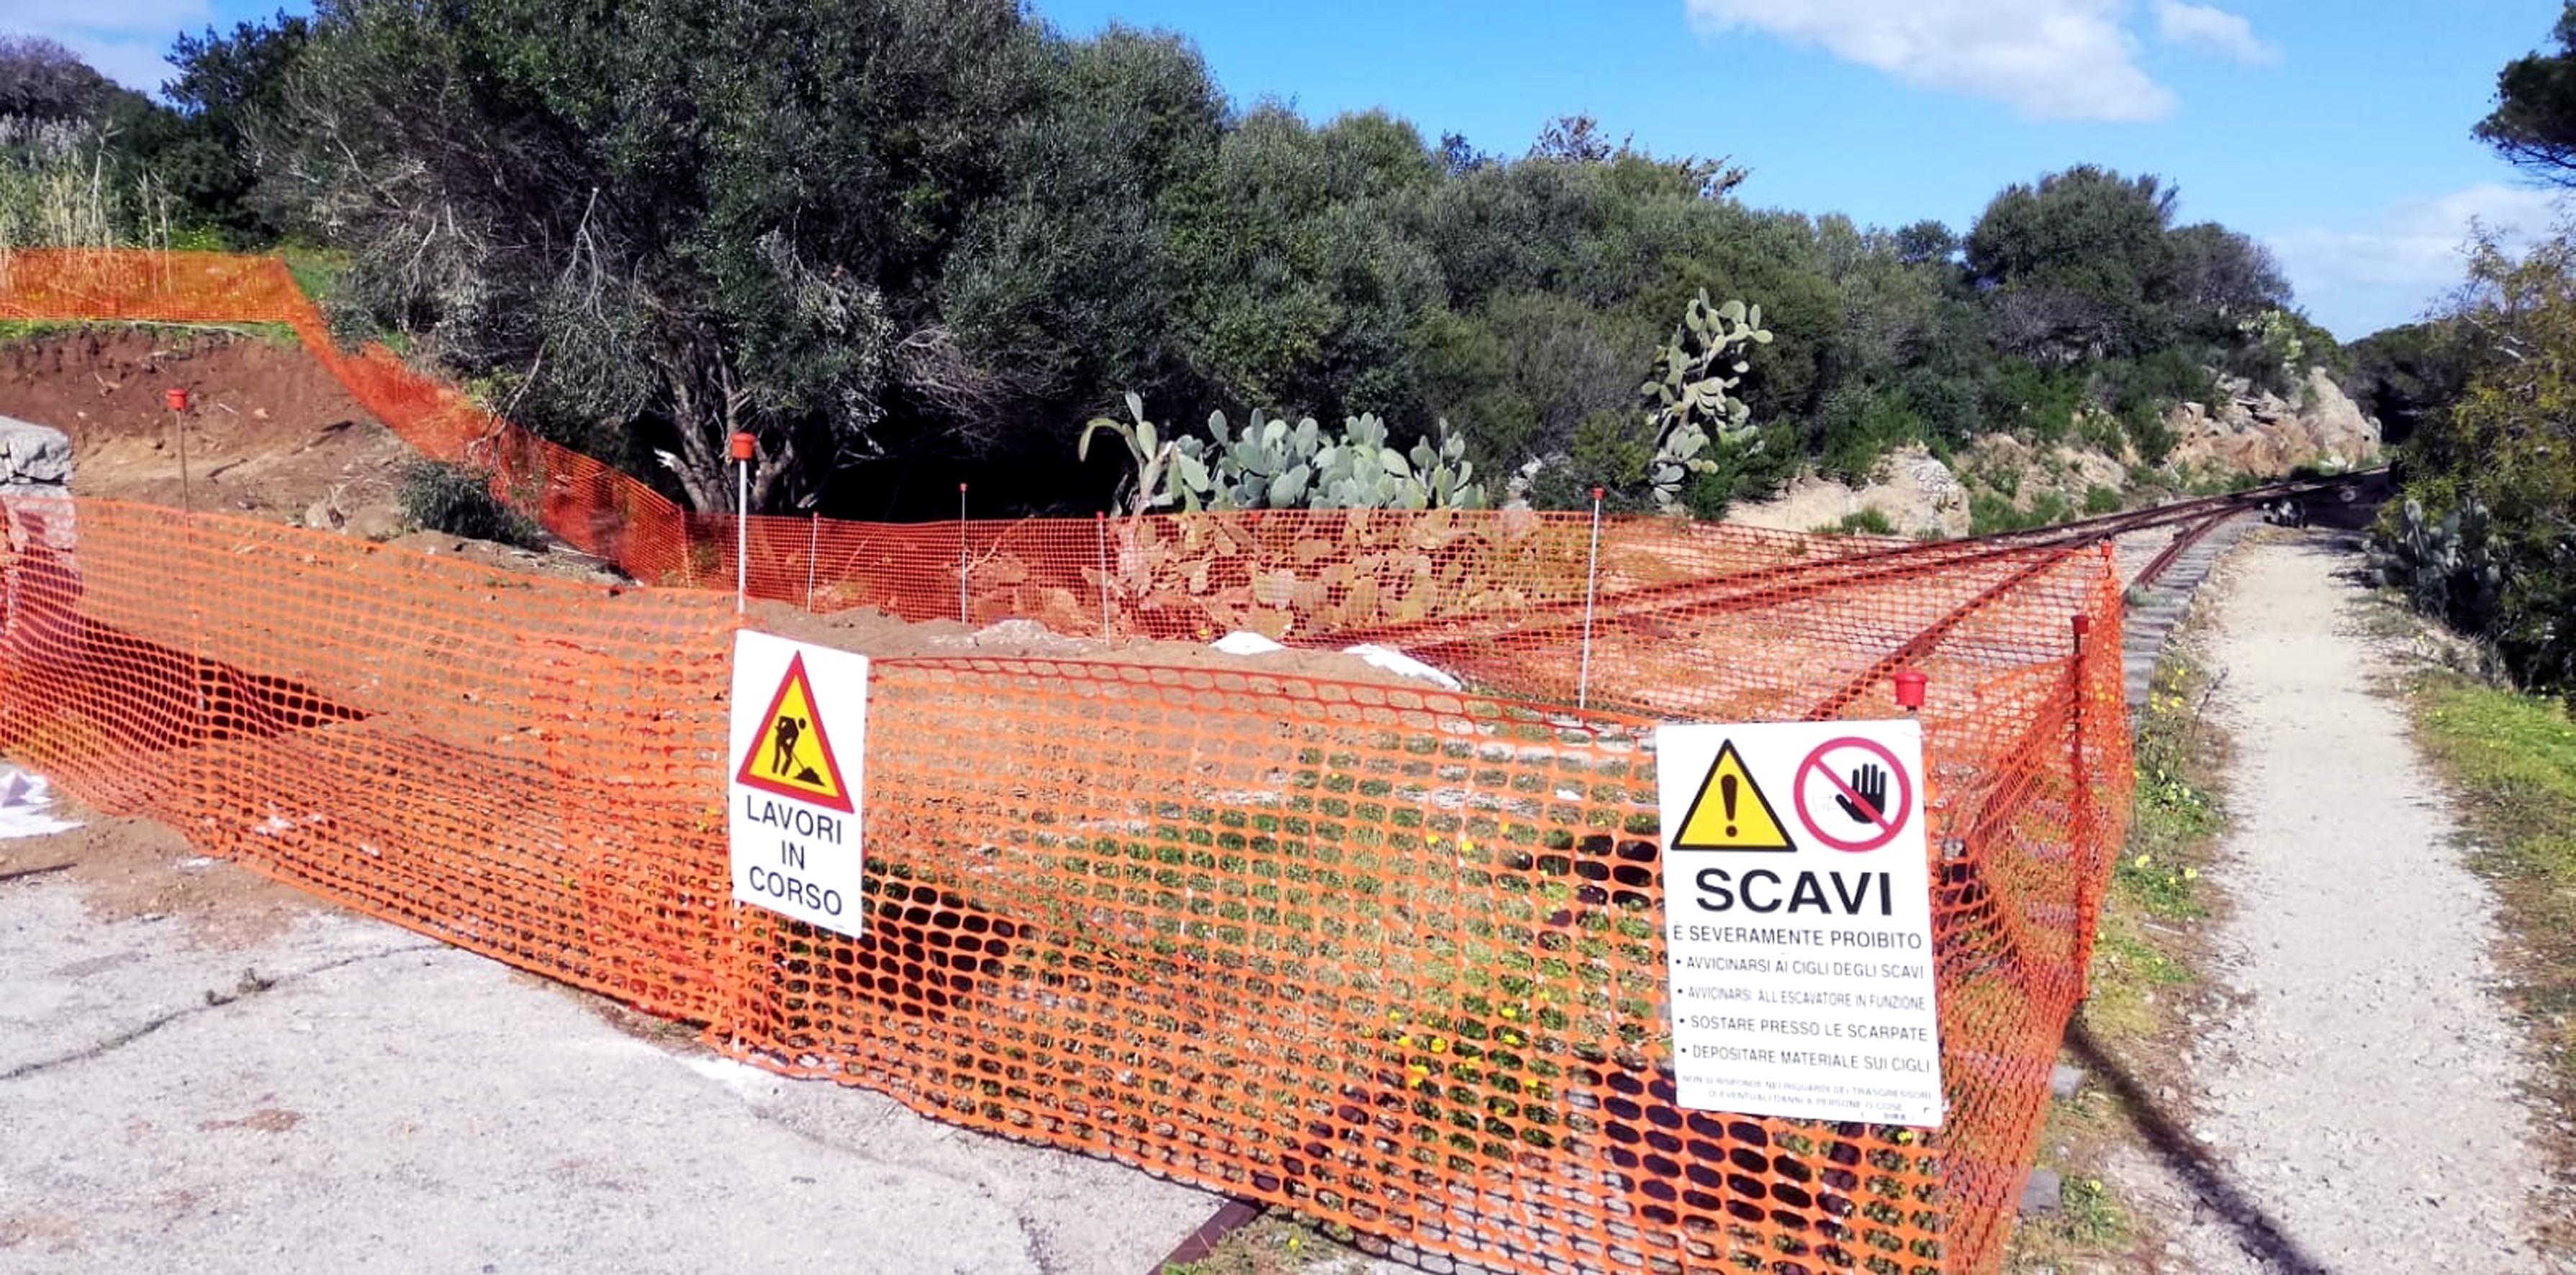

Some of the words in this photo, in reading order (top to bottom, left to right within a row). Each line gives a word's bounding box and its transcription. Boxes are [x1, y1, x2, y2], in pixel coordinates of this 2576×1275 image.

[746, 794, 841, 844] LAVORI
[782, 840, 805, 871] IN
[749, 866, 842, 915] CORSO
[1696, 868, 1892, 916] SCAVI
[1690, 926, 1823, 945] SEVERAMENTE
[1831, 930, 1921, 948] PROIBITO
[1687, 956, 1769, 972] AVVICINARSI
[1776, 961, 1787, 972] AI
[1793, 961, 1827, 974] CIGLI
[1834, 963, 1876, 976] DEGLI
[1882, 964, 1922, 978] SCAVI
[1856, 994, 1866, 1007] IN
[1870, 994, 1924, 1009] FUNZIONE
[1691, 1015, 1754, 1031] SOSTARE
[1761, 1020, 1820, 1035] PRESSO
[1825, 1024, 1842, 1037] LE
[1848, 1024, 1927, 1041] SCARPATE
[1694, 1045, 1774, 1063] DEPOSITARE
[1781, 1051, 1858, 1068] MATERIALE
[1865, 1056, 1886, 1069] SUI
[1892, 1058, 1929, 1072] CIGLI
